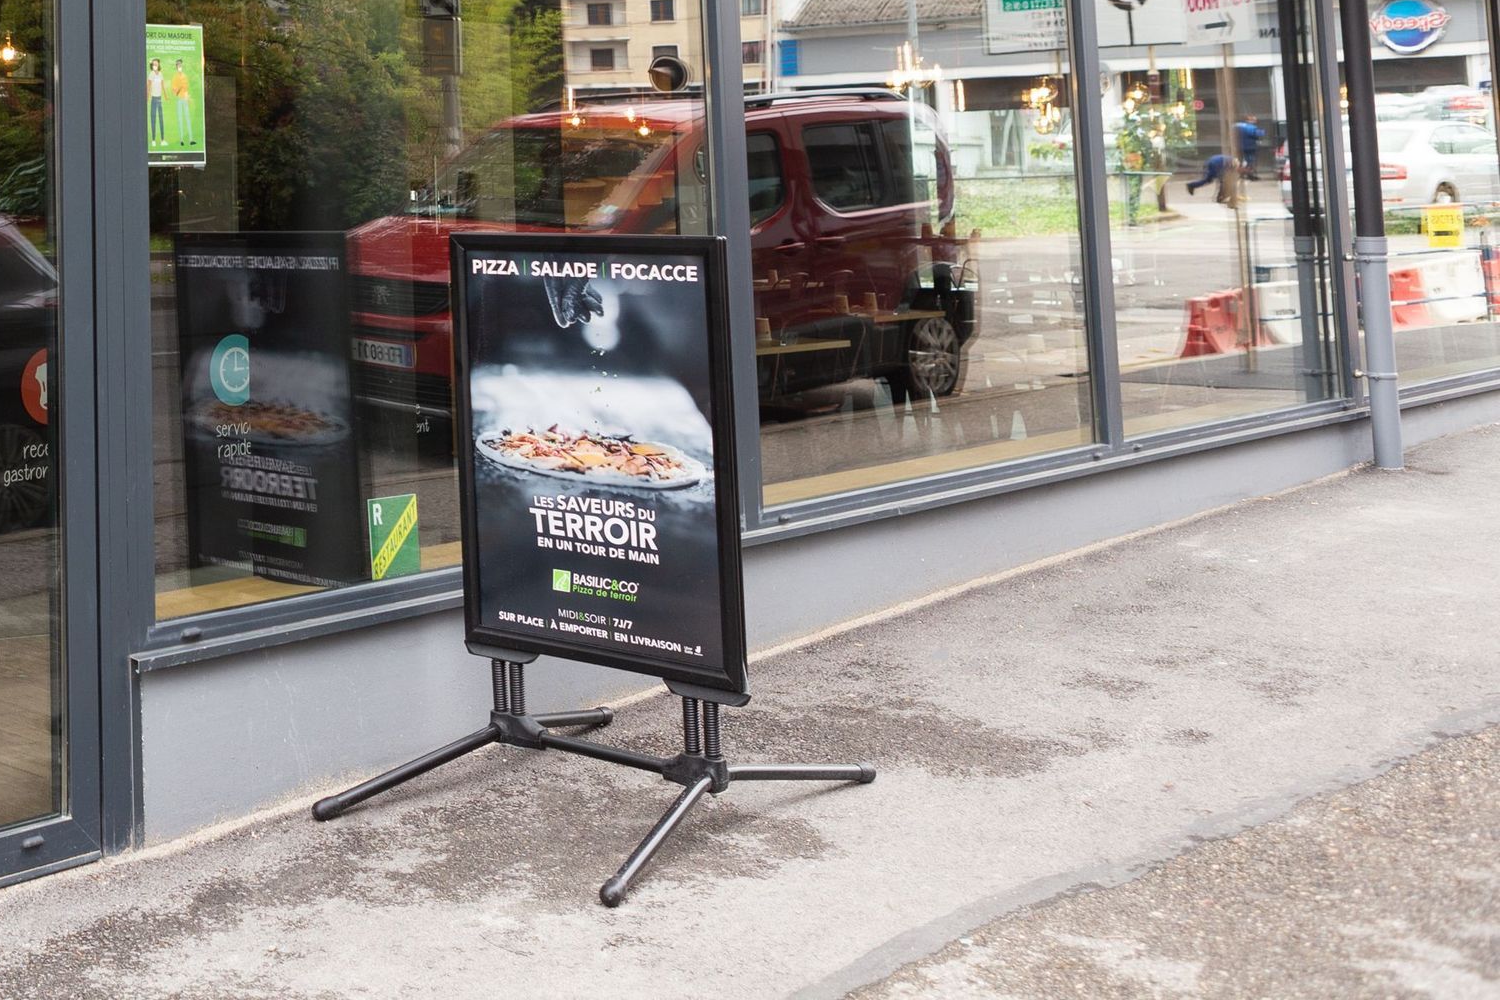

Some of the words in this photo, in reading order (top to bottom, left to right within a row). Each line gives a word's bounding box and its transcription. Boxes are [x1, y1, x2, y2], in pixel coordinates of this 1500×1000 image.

[472, 259, 519, 275] PIZZA
[531, 261, 597, 278] SALADE
[611, 263, 698, 282] FOCACCE
[216, 421, 251, 437] servic
[218, 438, 252, 460] rapide
[372, 503, 383, 526] R
[533, 496, 555, 509] LES
[557, 494, 635, 519] SAVEURS
[638, 508, 656, 522] DU
[374, 501, 417, 579] RESTAURANT
[529, 507, 659, 550] TERROIR
[537, 536, 553, 549] EN
[556, 539, 573, 552] UN
[575, 542, 606, 557] TOUR
[609, 547, 625, 560] DE
[628, 550, 660, 565] MAIN
[572, 584, 593, 596] Pizza
[596, 587, 608, 598] de
[610, 589, 638, 602] terroir
[558, 608, 606, 625] MIDI&SOIR
[613, 618, 633, 630] 7J/7
[499, 611, 516, 622] SUR
[517, 614, 544, 628] PLACE
[550, 619, 558, 630] À
[560, 622, 609, 640] EMPORTER
[615, 632, 629, 643] EN
[630, 634, 682, 653] LIVRAISON
